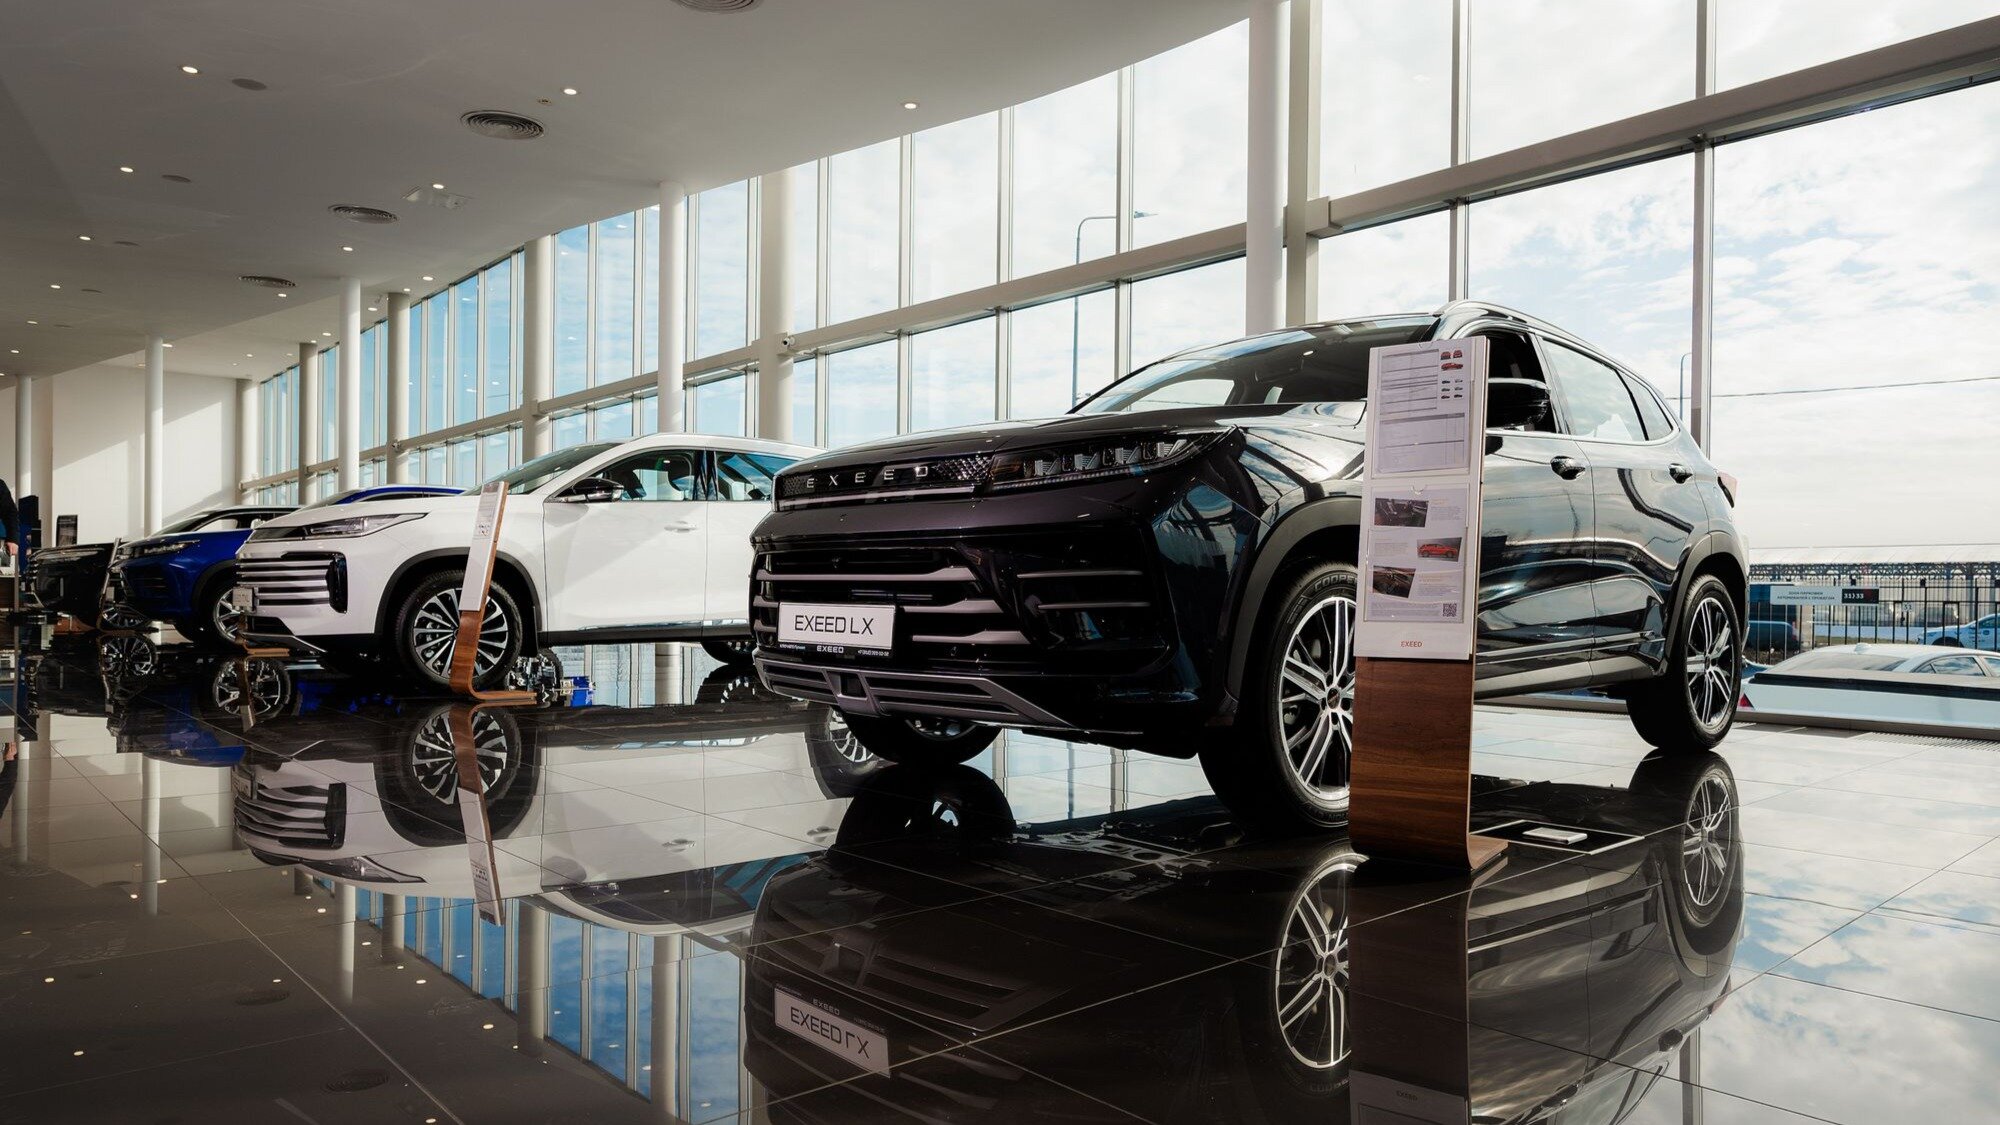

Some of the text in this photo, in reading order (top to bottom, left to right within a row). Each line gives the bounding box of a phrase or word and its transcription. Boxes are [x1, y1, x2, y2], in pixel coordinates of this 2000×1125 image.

[806, 466, 928, 488] EXEED
[794, 614, 874, 635] EXEED LX
[816, 645, 845, 654] EXEED
[1400, 640, 1423, 648] EXEED
